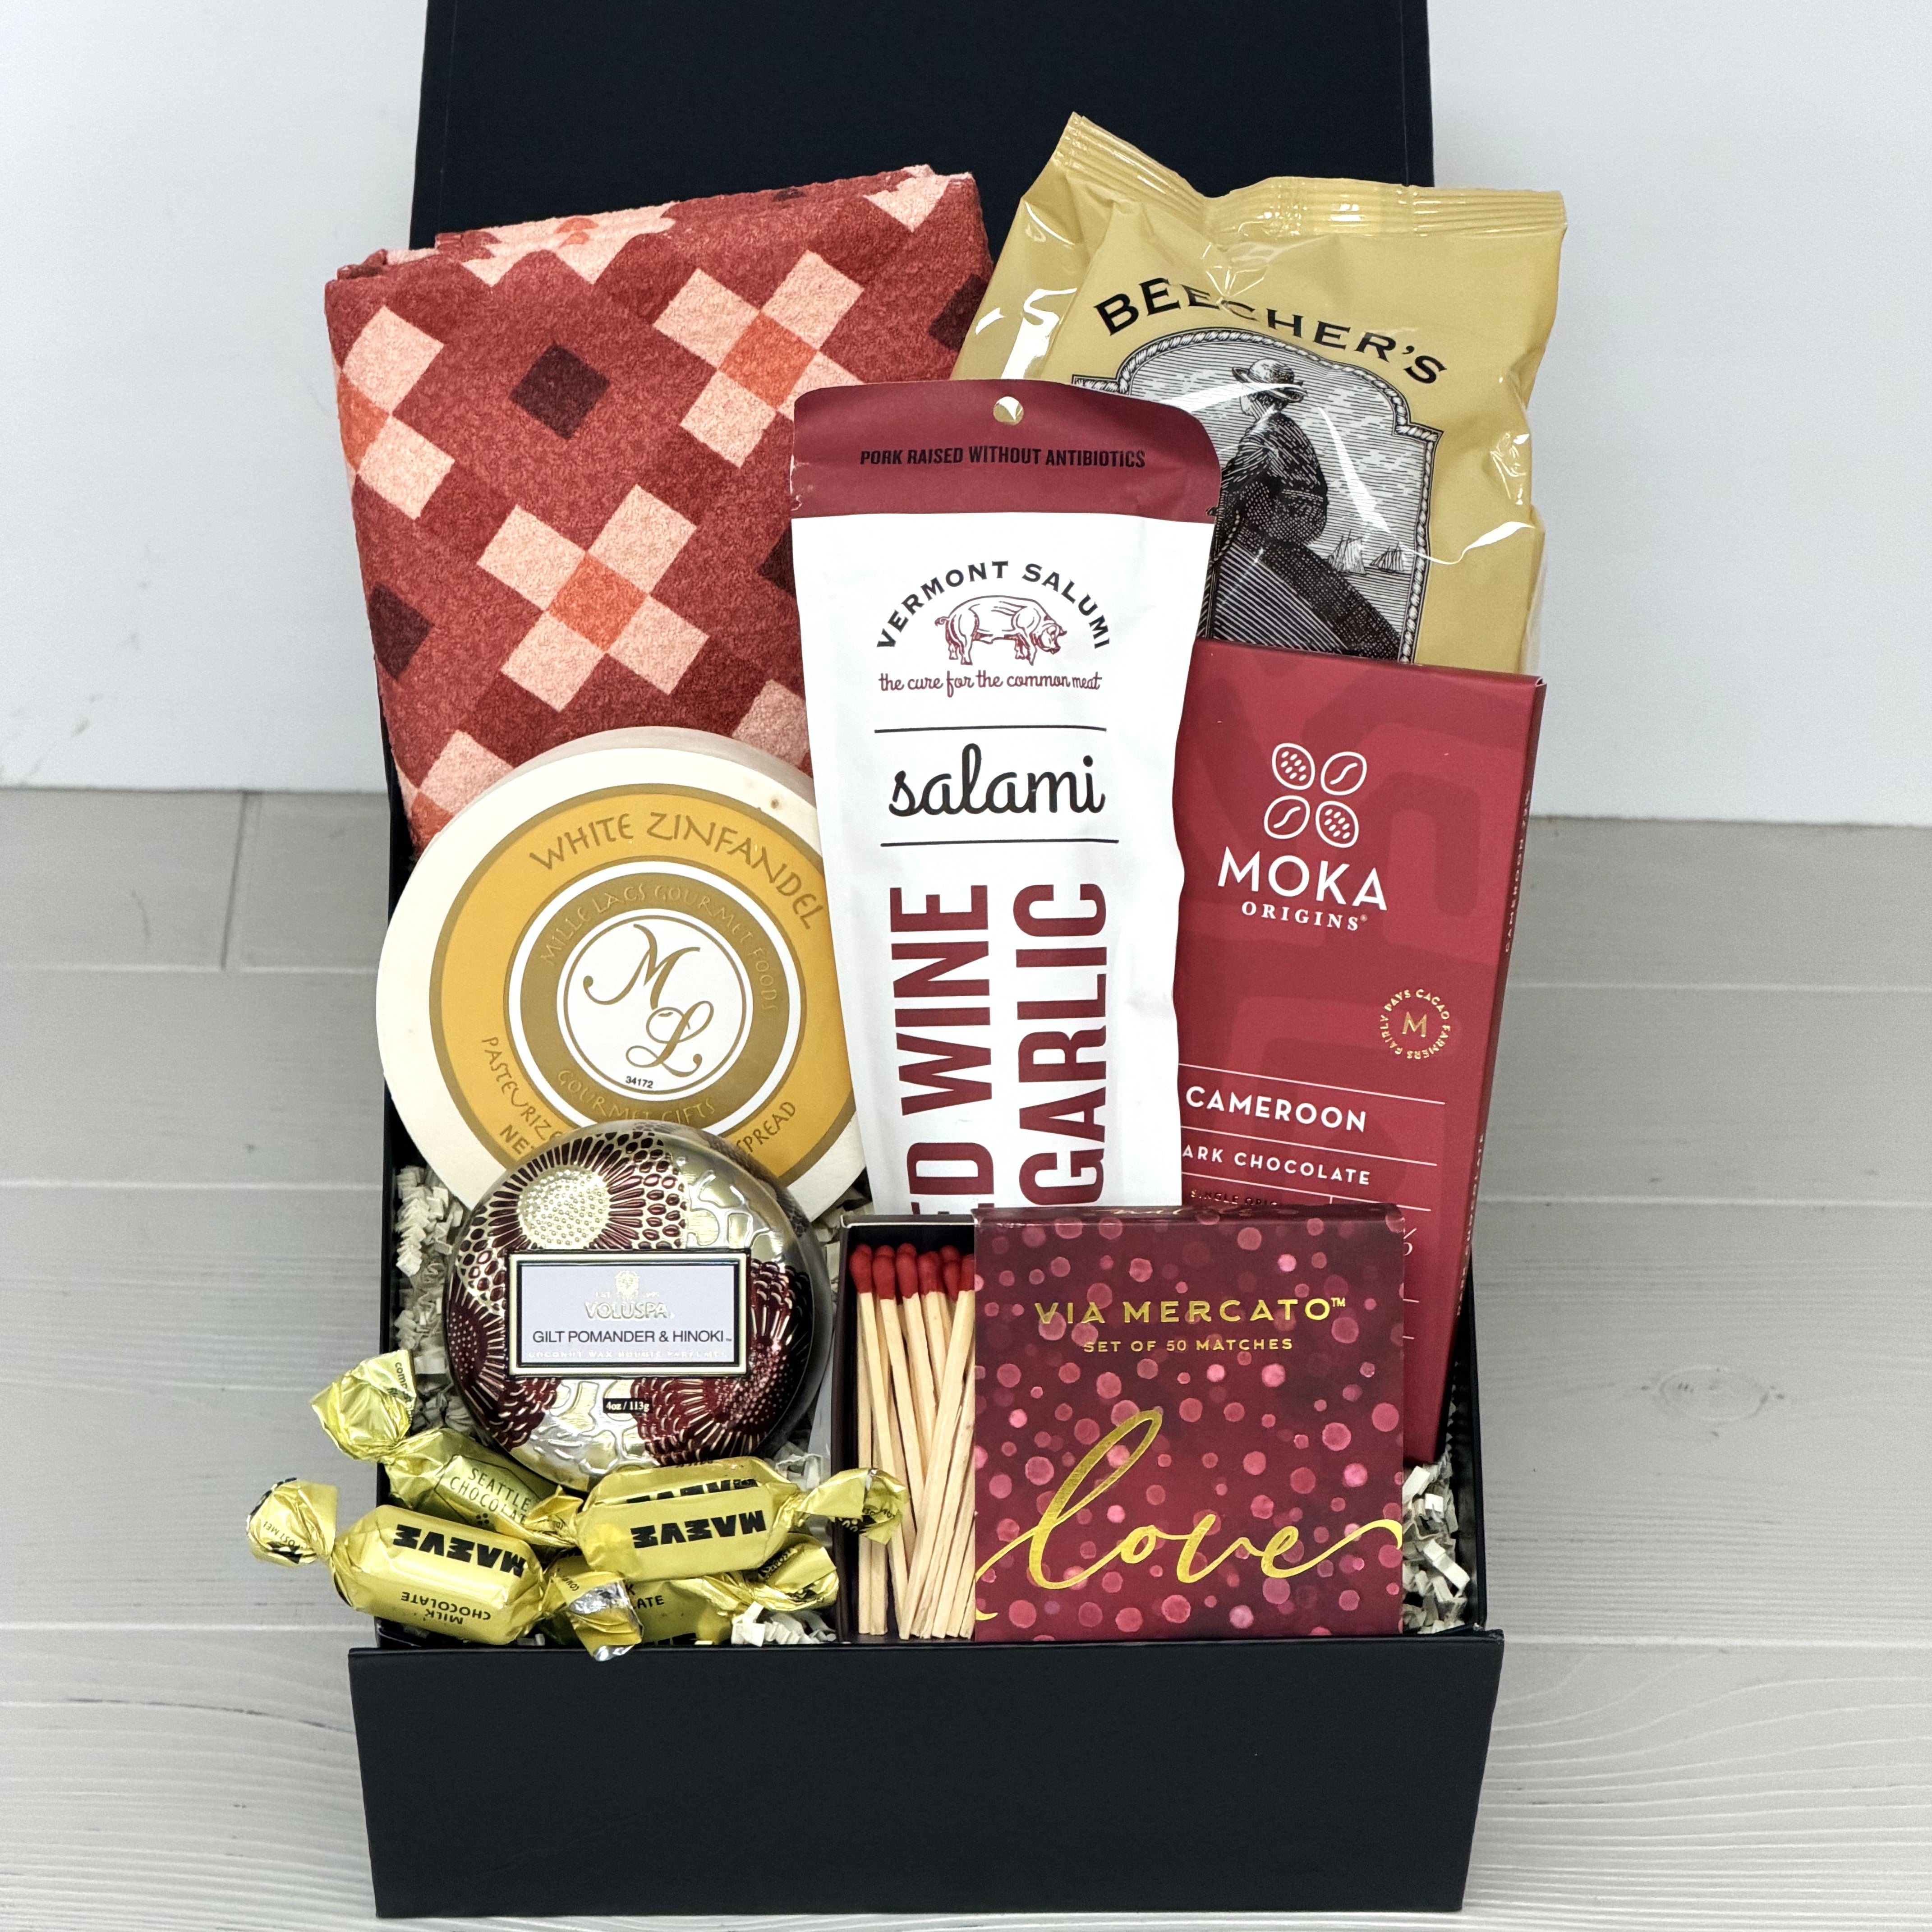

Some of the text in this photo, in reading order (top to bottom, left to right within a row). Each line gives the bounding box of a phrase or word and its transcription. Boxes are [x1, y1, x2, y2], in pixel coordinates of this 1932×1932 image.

[1094, 278, 1447, 384] BEECHER'S
[860, 446, 1146, 468] PORK RAISED WITHOUT ANTIBIOTICS
[877, 561, 1110, 649] VERMONT SALUMI
[879, 670, 1102, 698] the cure for the common meat
[889, 743, 1106, 817] salami
[529, 811, 823, 929] WHITE ZINFANDEL
[1218, 846, 1387, 911] MOKA
[540, 883, 778, 1012] MILLE LACS GOURMET FOODS
[890, 885, 992, 1116] WINE
[1013, 883, 1107, 1206] GARLIC
[1380, 989, 1451, 1059] FAIRLY PAYS CACAO FARMERS
[1402, 1012, 1427, 1037] M
[558, 1070, 716, 1125] GOURMET GIFTS
[626, 1076, 653, 1089] 34172
[1186, 1086, 1366, 1133] CAMEROON
[499, 1124, 535, 1155] NE
[1182, 1145, 1370, 1186] ARK CHOCOLATE
[1035, 1302, 1105, 1324] VIA
[532, 1331, 565, 1343] GILT
[568, 1330, 655, 1343] POMANDER
[658, 1331, 669, 1342] &
[1083, 1338, 1293, 1352] SET OF 50 MATCHES
[606, 1401, 622, 1410] 4oz
[629, 1401, 650, 1412] 113g
[450, 1476, 528, 1524] CHOCOLAT
[468, 1468, 532, 1512] SEATTLE
[975, 1409, 1402, 1590] love
[393, 1523, 528, 1578] MAEVE
[630, 1510, 767, 1549] MAEVE
[401, 1592, 491, 1620] CHOCOLATE
[424, 1609, 463, 1625] MILK
